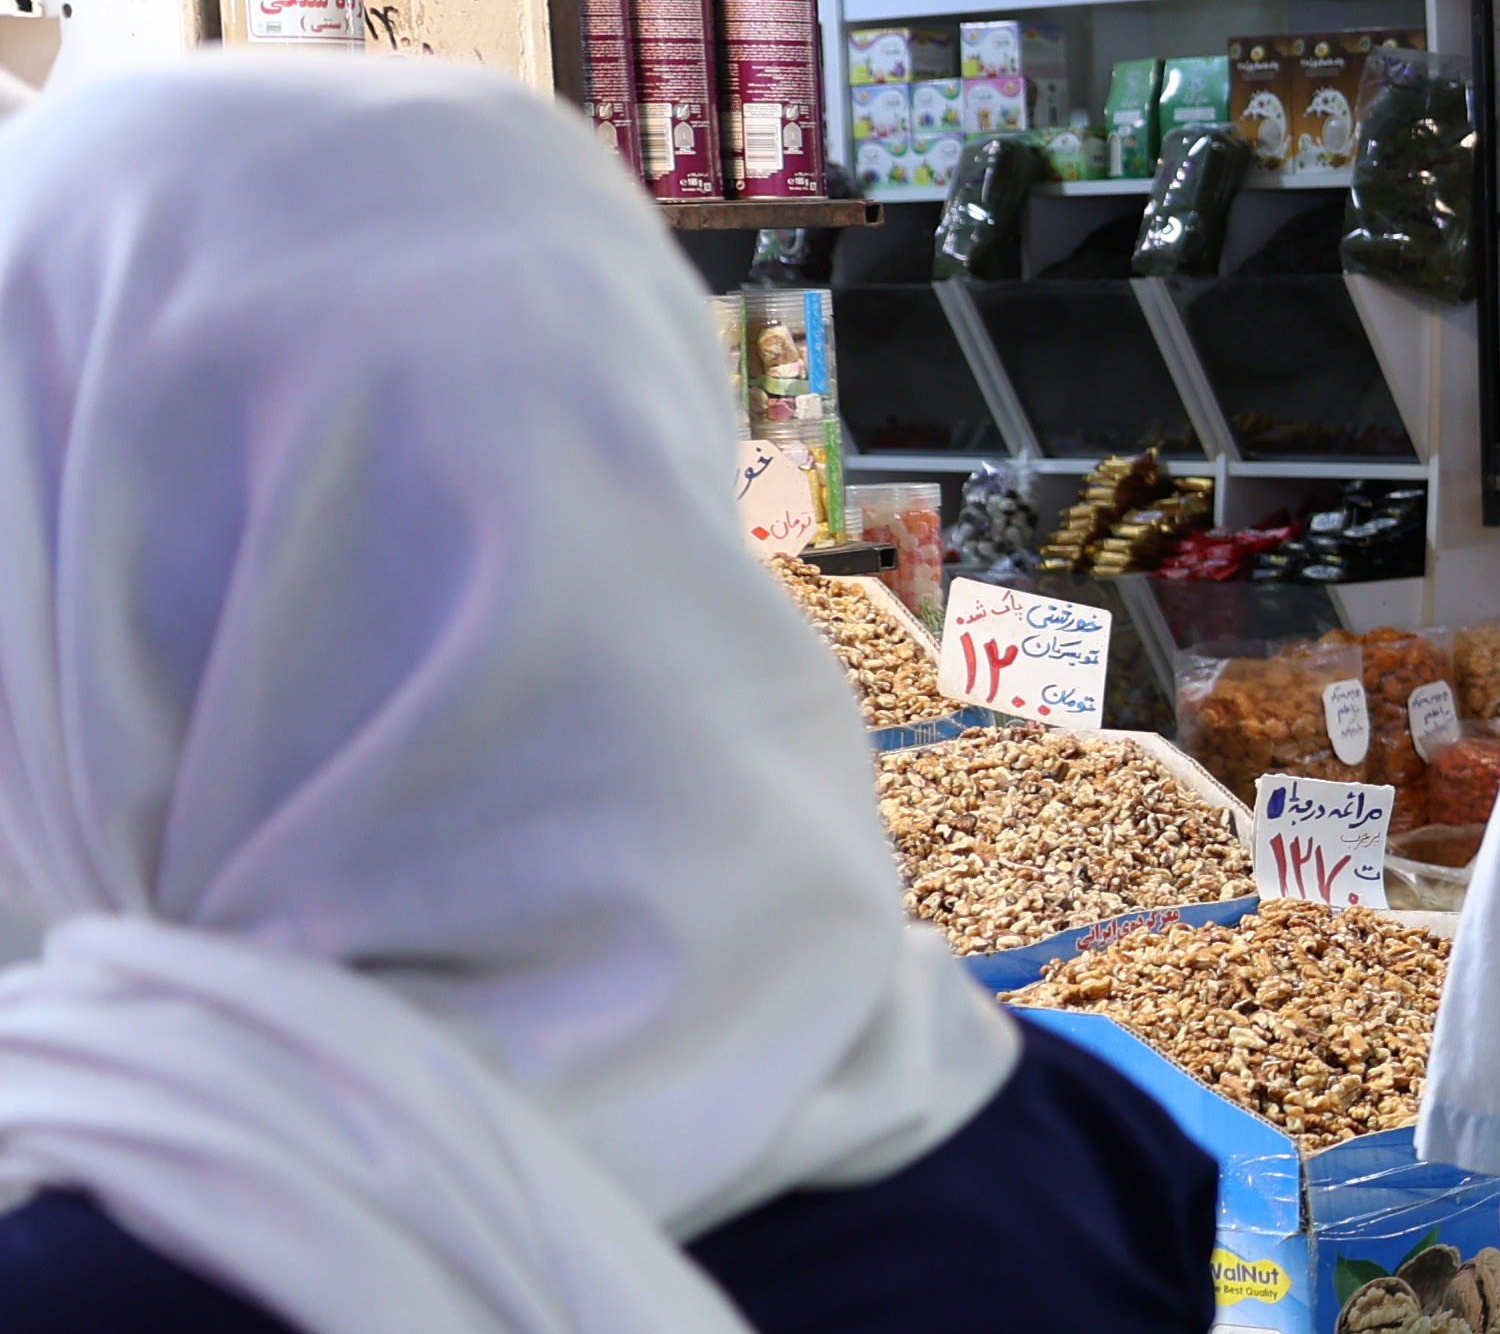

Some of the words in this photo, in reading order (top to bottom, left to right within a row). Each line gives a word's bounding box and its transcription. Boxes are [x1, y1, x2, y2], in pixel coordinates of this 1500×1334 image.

[770, 510, 813, 541] تومان
[955, 599, 988, 626] شده
[991, 589, 1024, 622] پاک
[1041, 683, 1096, 714] تومان
[1269, 832, 1359, 905] ۱۲۷۰
[1353, 864, 1381, 881] ت
[1223, 1284, 1243, 1295] Best
[1245, 1286, 1278, 1301] Quality
